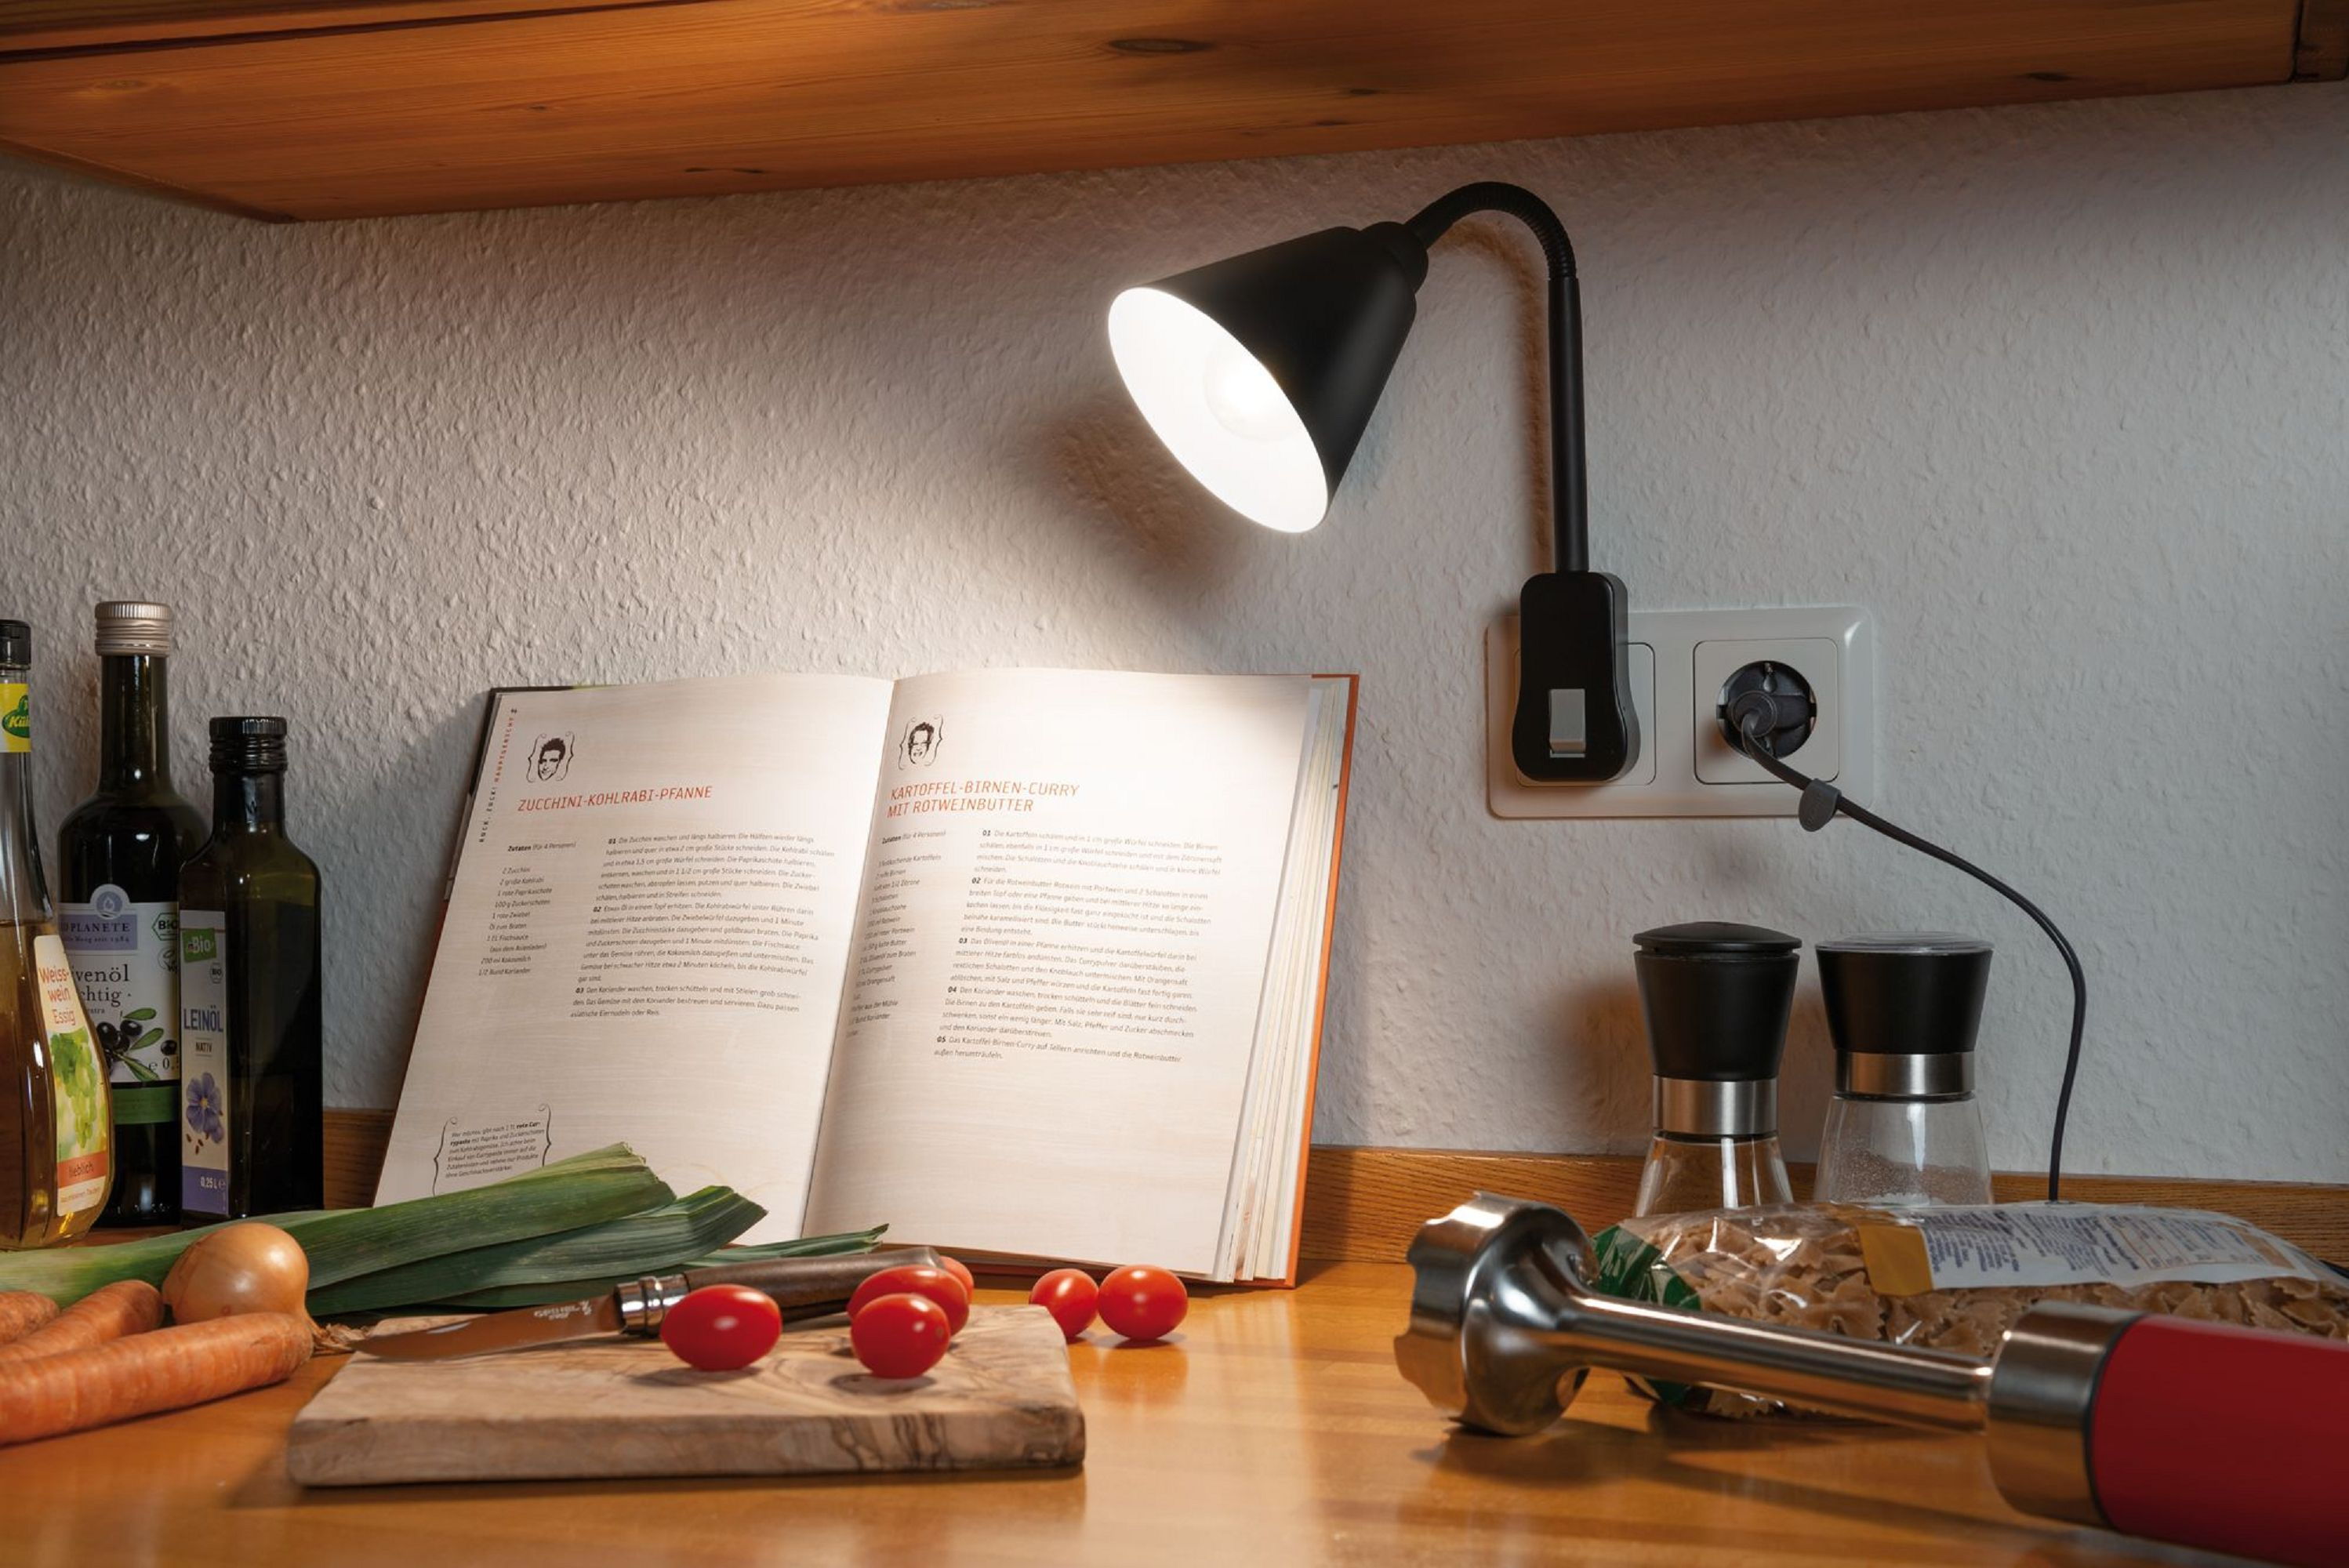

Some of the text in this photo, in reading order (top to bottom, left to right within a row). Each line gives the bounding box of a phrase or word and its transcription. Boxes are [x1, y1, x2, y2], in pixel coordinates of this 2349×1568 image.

[517, 786, 713, 811] ZUCCHINI-KOHLRABI-PFANNE
[891, 780, 1080, 800] KARTOFFEL-BIRNEN-CURRY
[887, 798, 1034, 818] MIT ROTWEINBUTTER
[71, 923, 130, 932] PLANETE
[71, 964, 131, 982] ivenöl
[48, 985, 71, 1002] wein
[79, 985, 122, 1007] chtig
[52, 1007, 76, 1026] Essig
[183, 1005, 224, 1033] LEINÖL
[196, 1042, 212, 1052] NATIV
